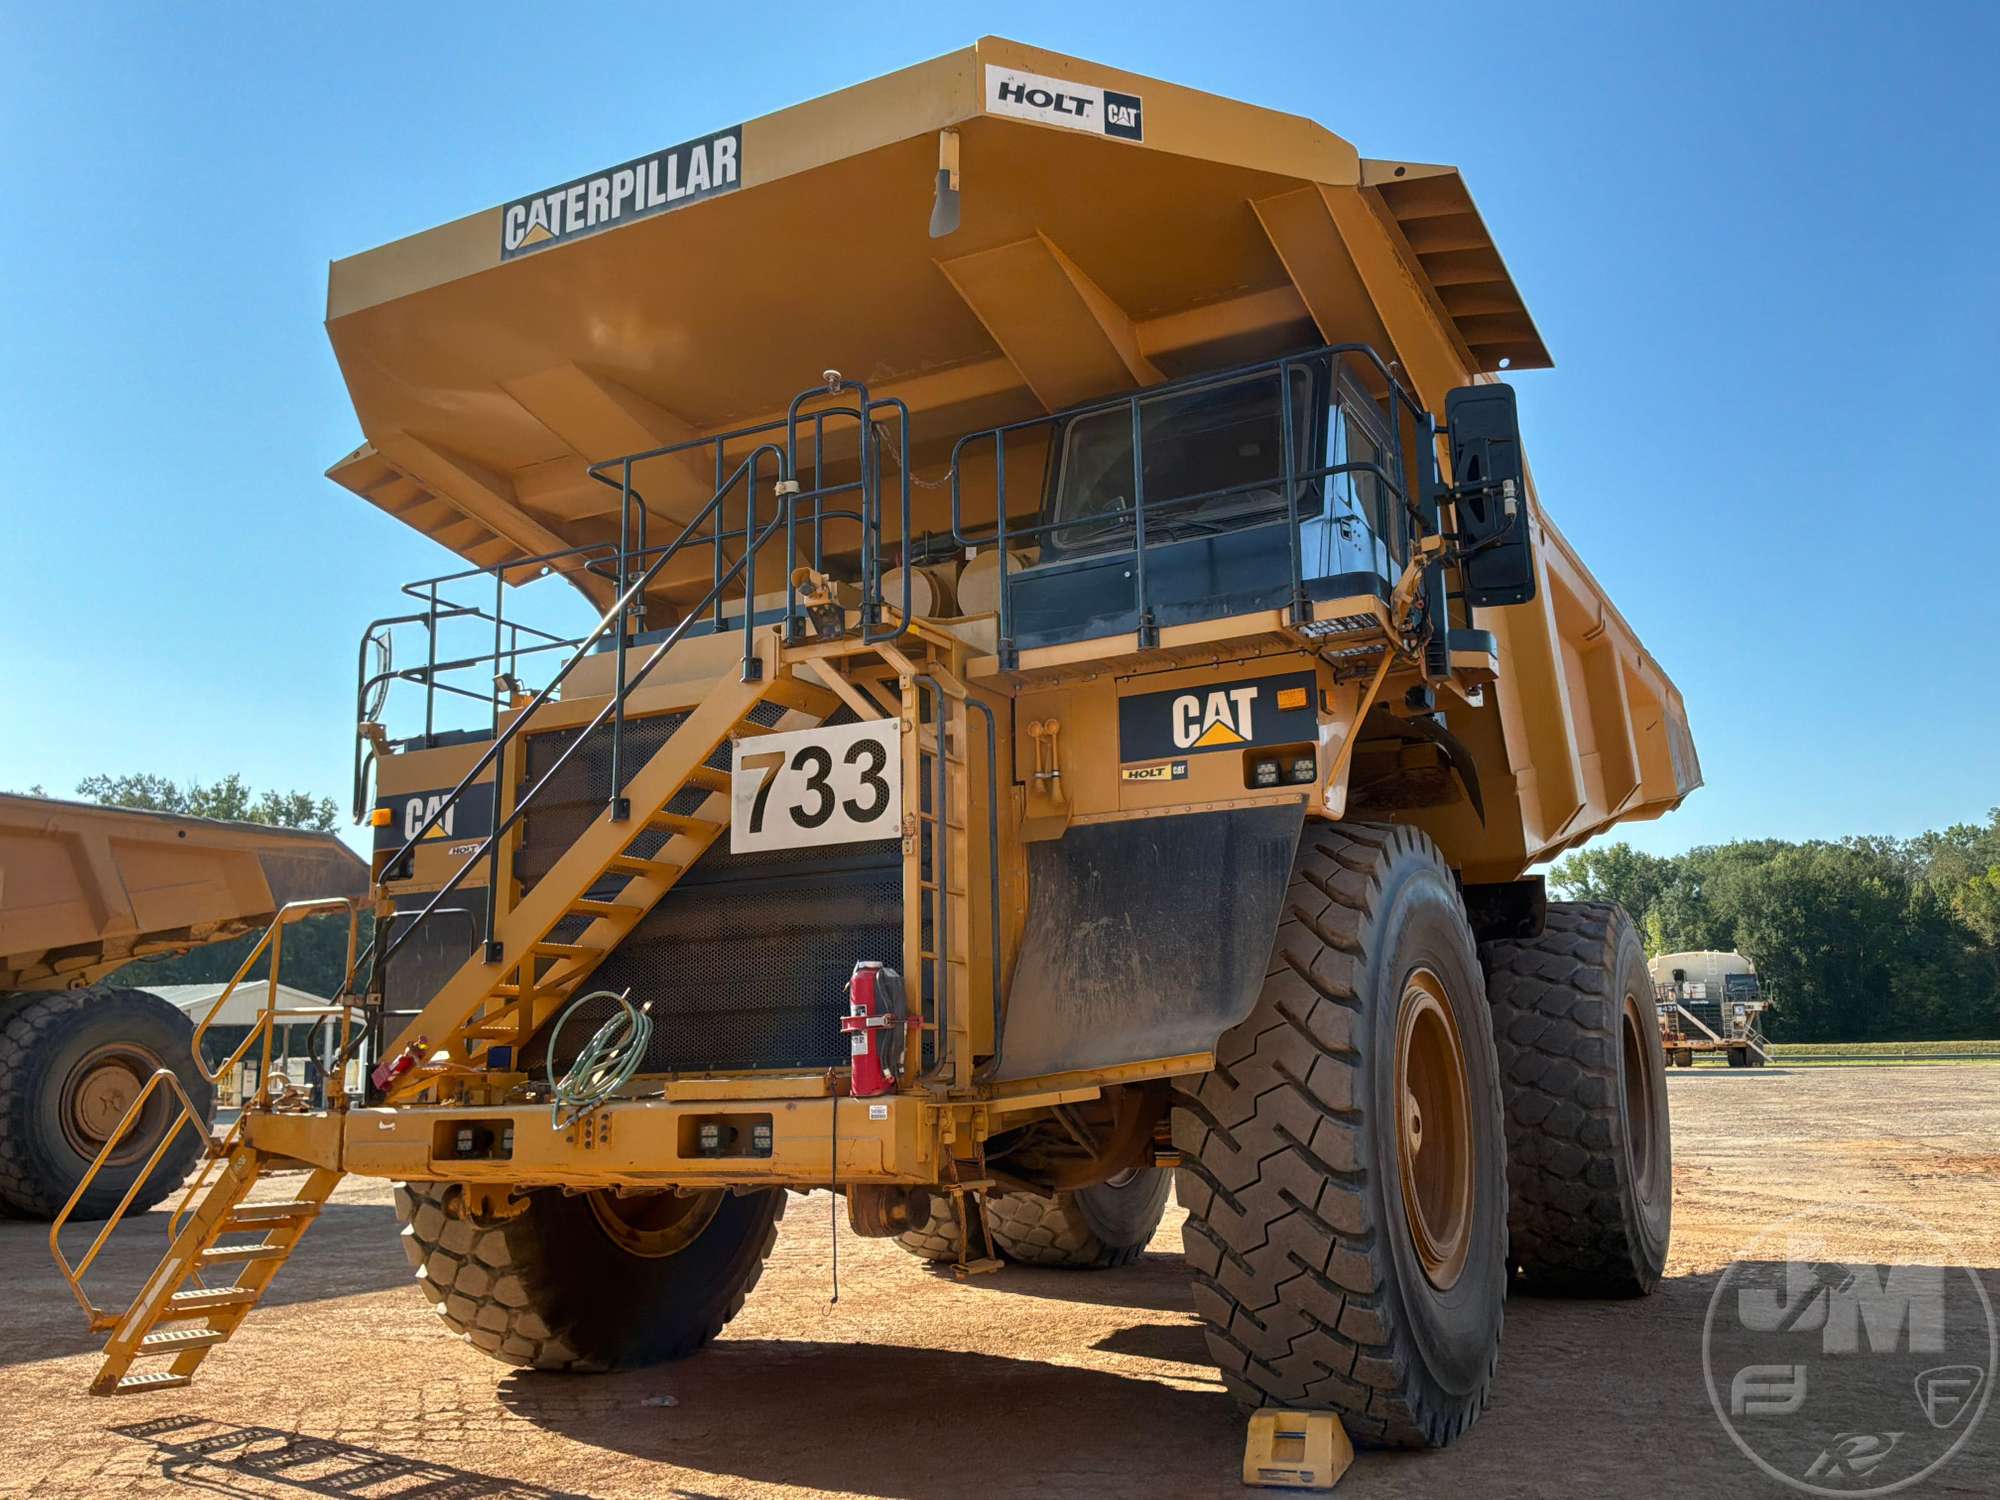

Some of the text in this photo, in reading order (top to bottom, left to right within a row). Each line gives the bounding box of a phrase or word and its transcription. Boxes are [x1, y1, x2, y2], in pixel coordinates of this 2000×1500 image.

[998, 81, 1138, 128] HOLT CAT
[504, 135, 737, 250] CATERPILLAR
[1172, 686, 1258, 749] CAT
[741, 737, 891, 834] 733
[1128, 767, 1165, 779] HOLT
